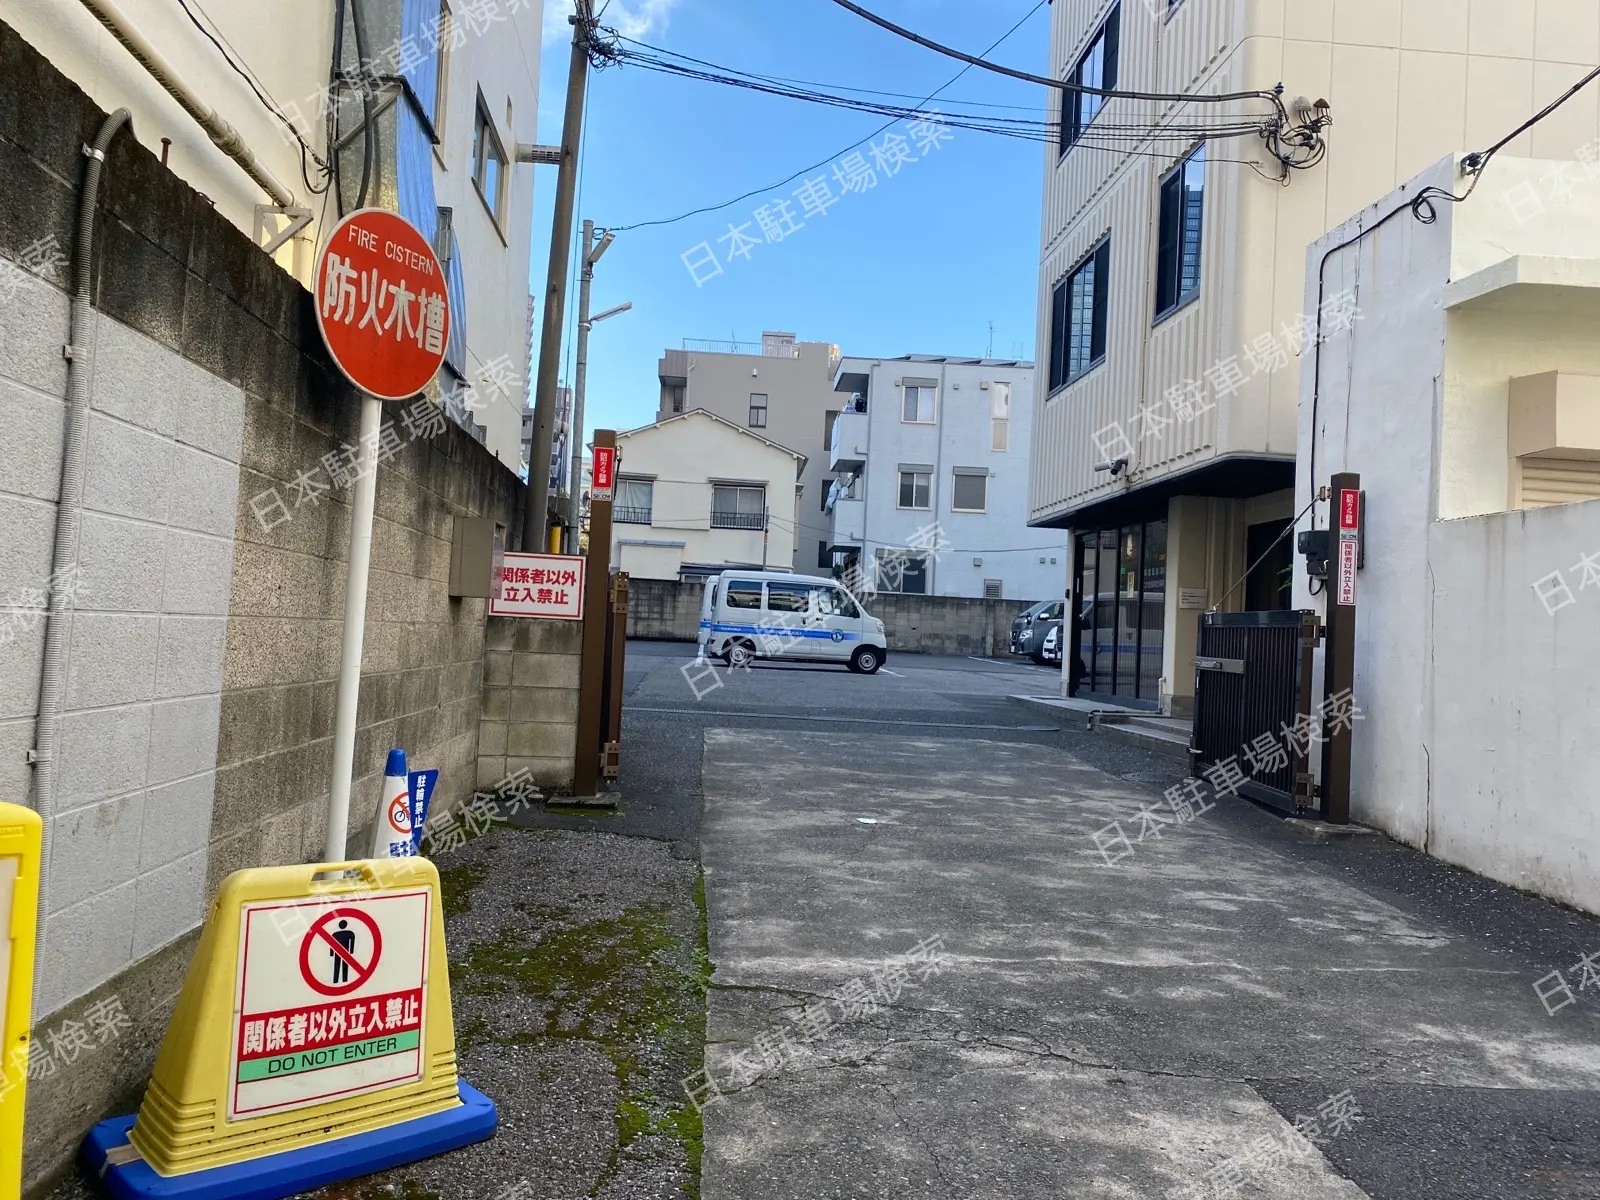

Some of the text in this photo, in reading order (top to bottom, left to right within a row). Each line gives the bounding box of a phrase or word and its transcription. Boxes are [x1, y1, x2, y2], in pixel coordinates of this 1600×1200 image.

[348, 224, 434, 276] FIRE CISTERN
[504, 586, 569, 605] 立入禁止
[1343, 544, 1352, 602] 関係者以外立入禁止
[414, 775, 426, 828] 駐輪禁止
[243, 995, 418, 1055] 関係者以外立入禁止
[268, 1037, 397, 1074] DO NOT ENTER
